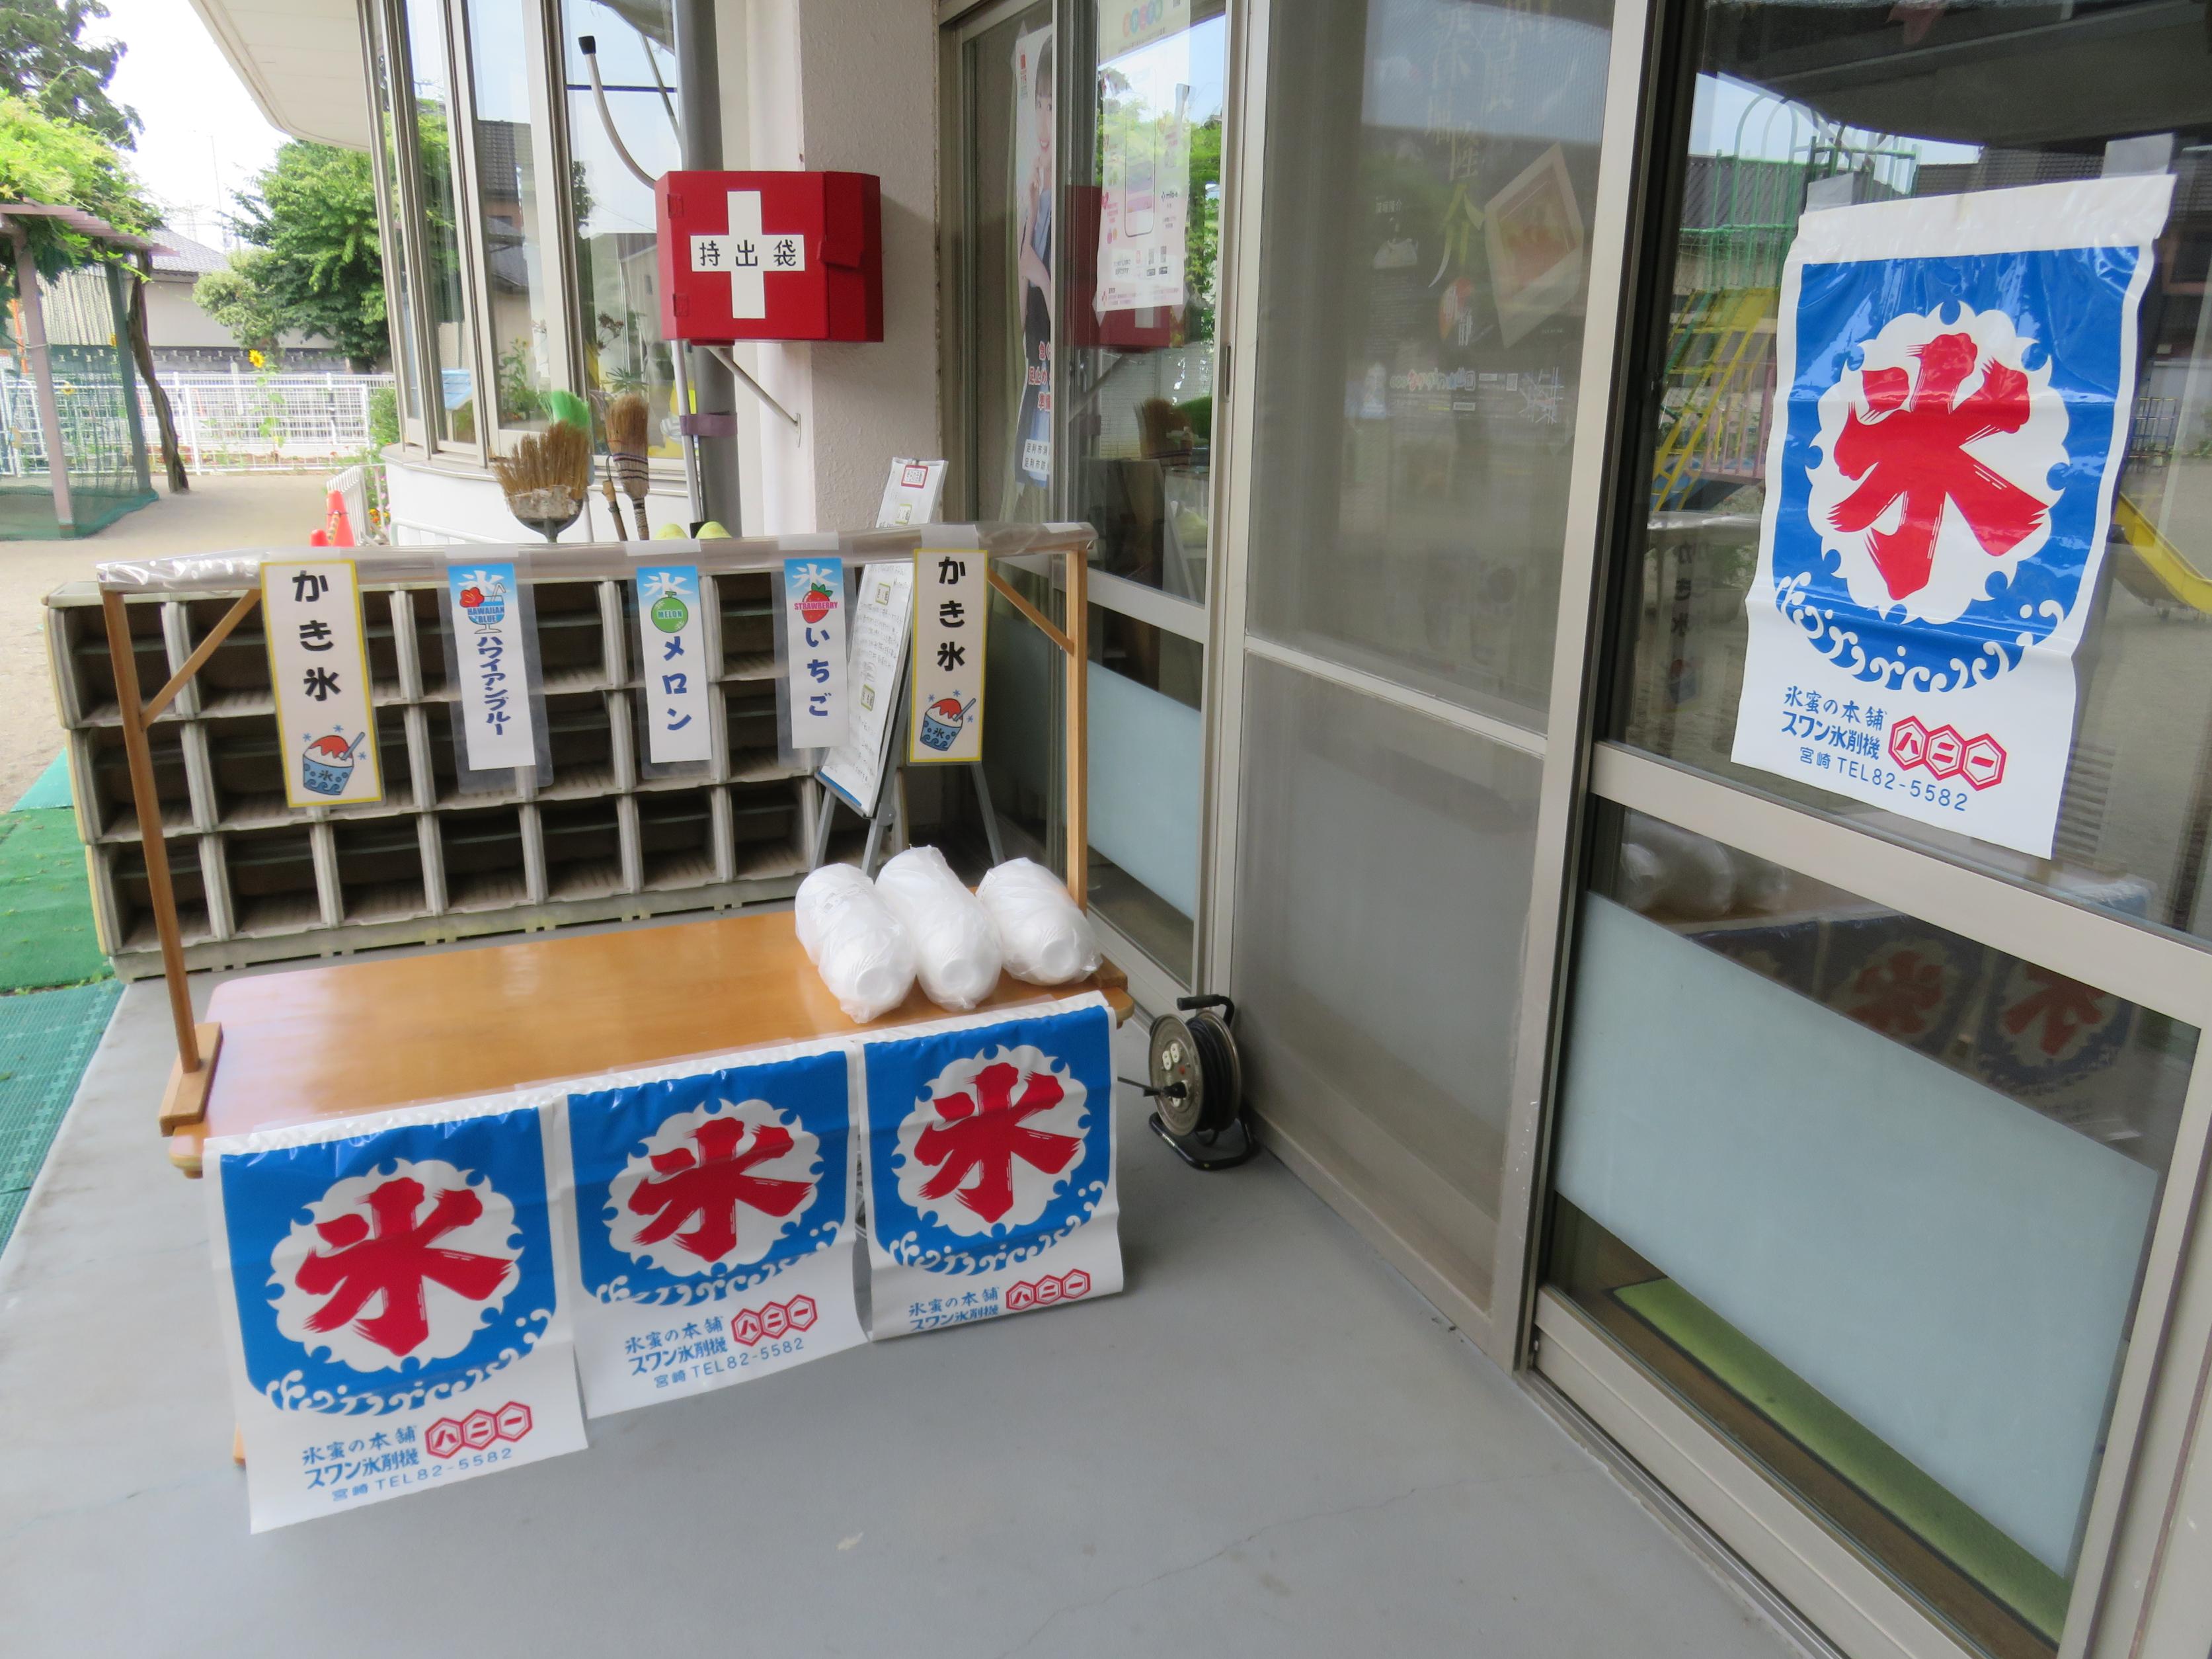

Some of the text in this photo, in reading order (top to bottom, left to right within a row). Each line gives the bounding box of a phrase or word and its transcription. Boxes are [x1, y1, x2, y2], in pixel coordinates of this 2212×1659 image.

[699, 239, 797, 267] 持出袋
[1825, 332, 2049, 602] 氷
[467, 606, 505, 616] HAWAIIAN
[477, 615, 497, 624] BLUE
[657, 610, 683, 619] MELON
[793, 601, 838, 610] STRAWBERRY
[937, 555, 967, 672] かき氷
[292, 569, 342, 702] かき氷
[477, 636, 512, 735] ハワイアンブルー
[662, 635, 692, 731] メロン
[805, 626, 832, 717] いちご
[1782, 685, 1888, 732] 氷蜜の本舗
[1781, 710, 1881, 760] スワン氷削機
[1799, 746, 1831, 770] 宮崎
[914, 1062, 1082, 1224] 氷
[628, 1116, 816, 1263] 氷
[294, 1176, 514, 1357] 氷
[908, 1287, 1000, 1318] 氷蜜の本舗
[625, 1316, 724, 1355] 氷蜜の本舗
[628, 1336, 729, 1377] スワン氷削機
[301, 1425, 418, 1466] 氷蜜の本舗
[305, 1448, 420, 1490] スワン氷削機
